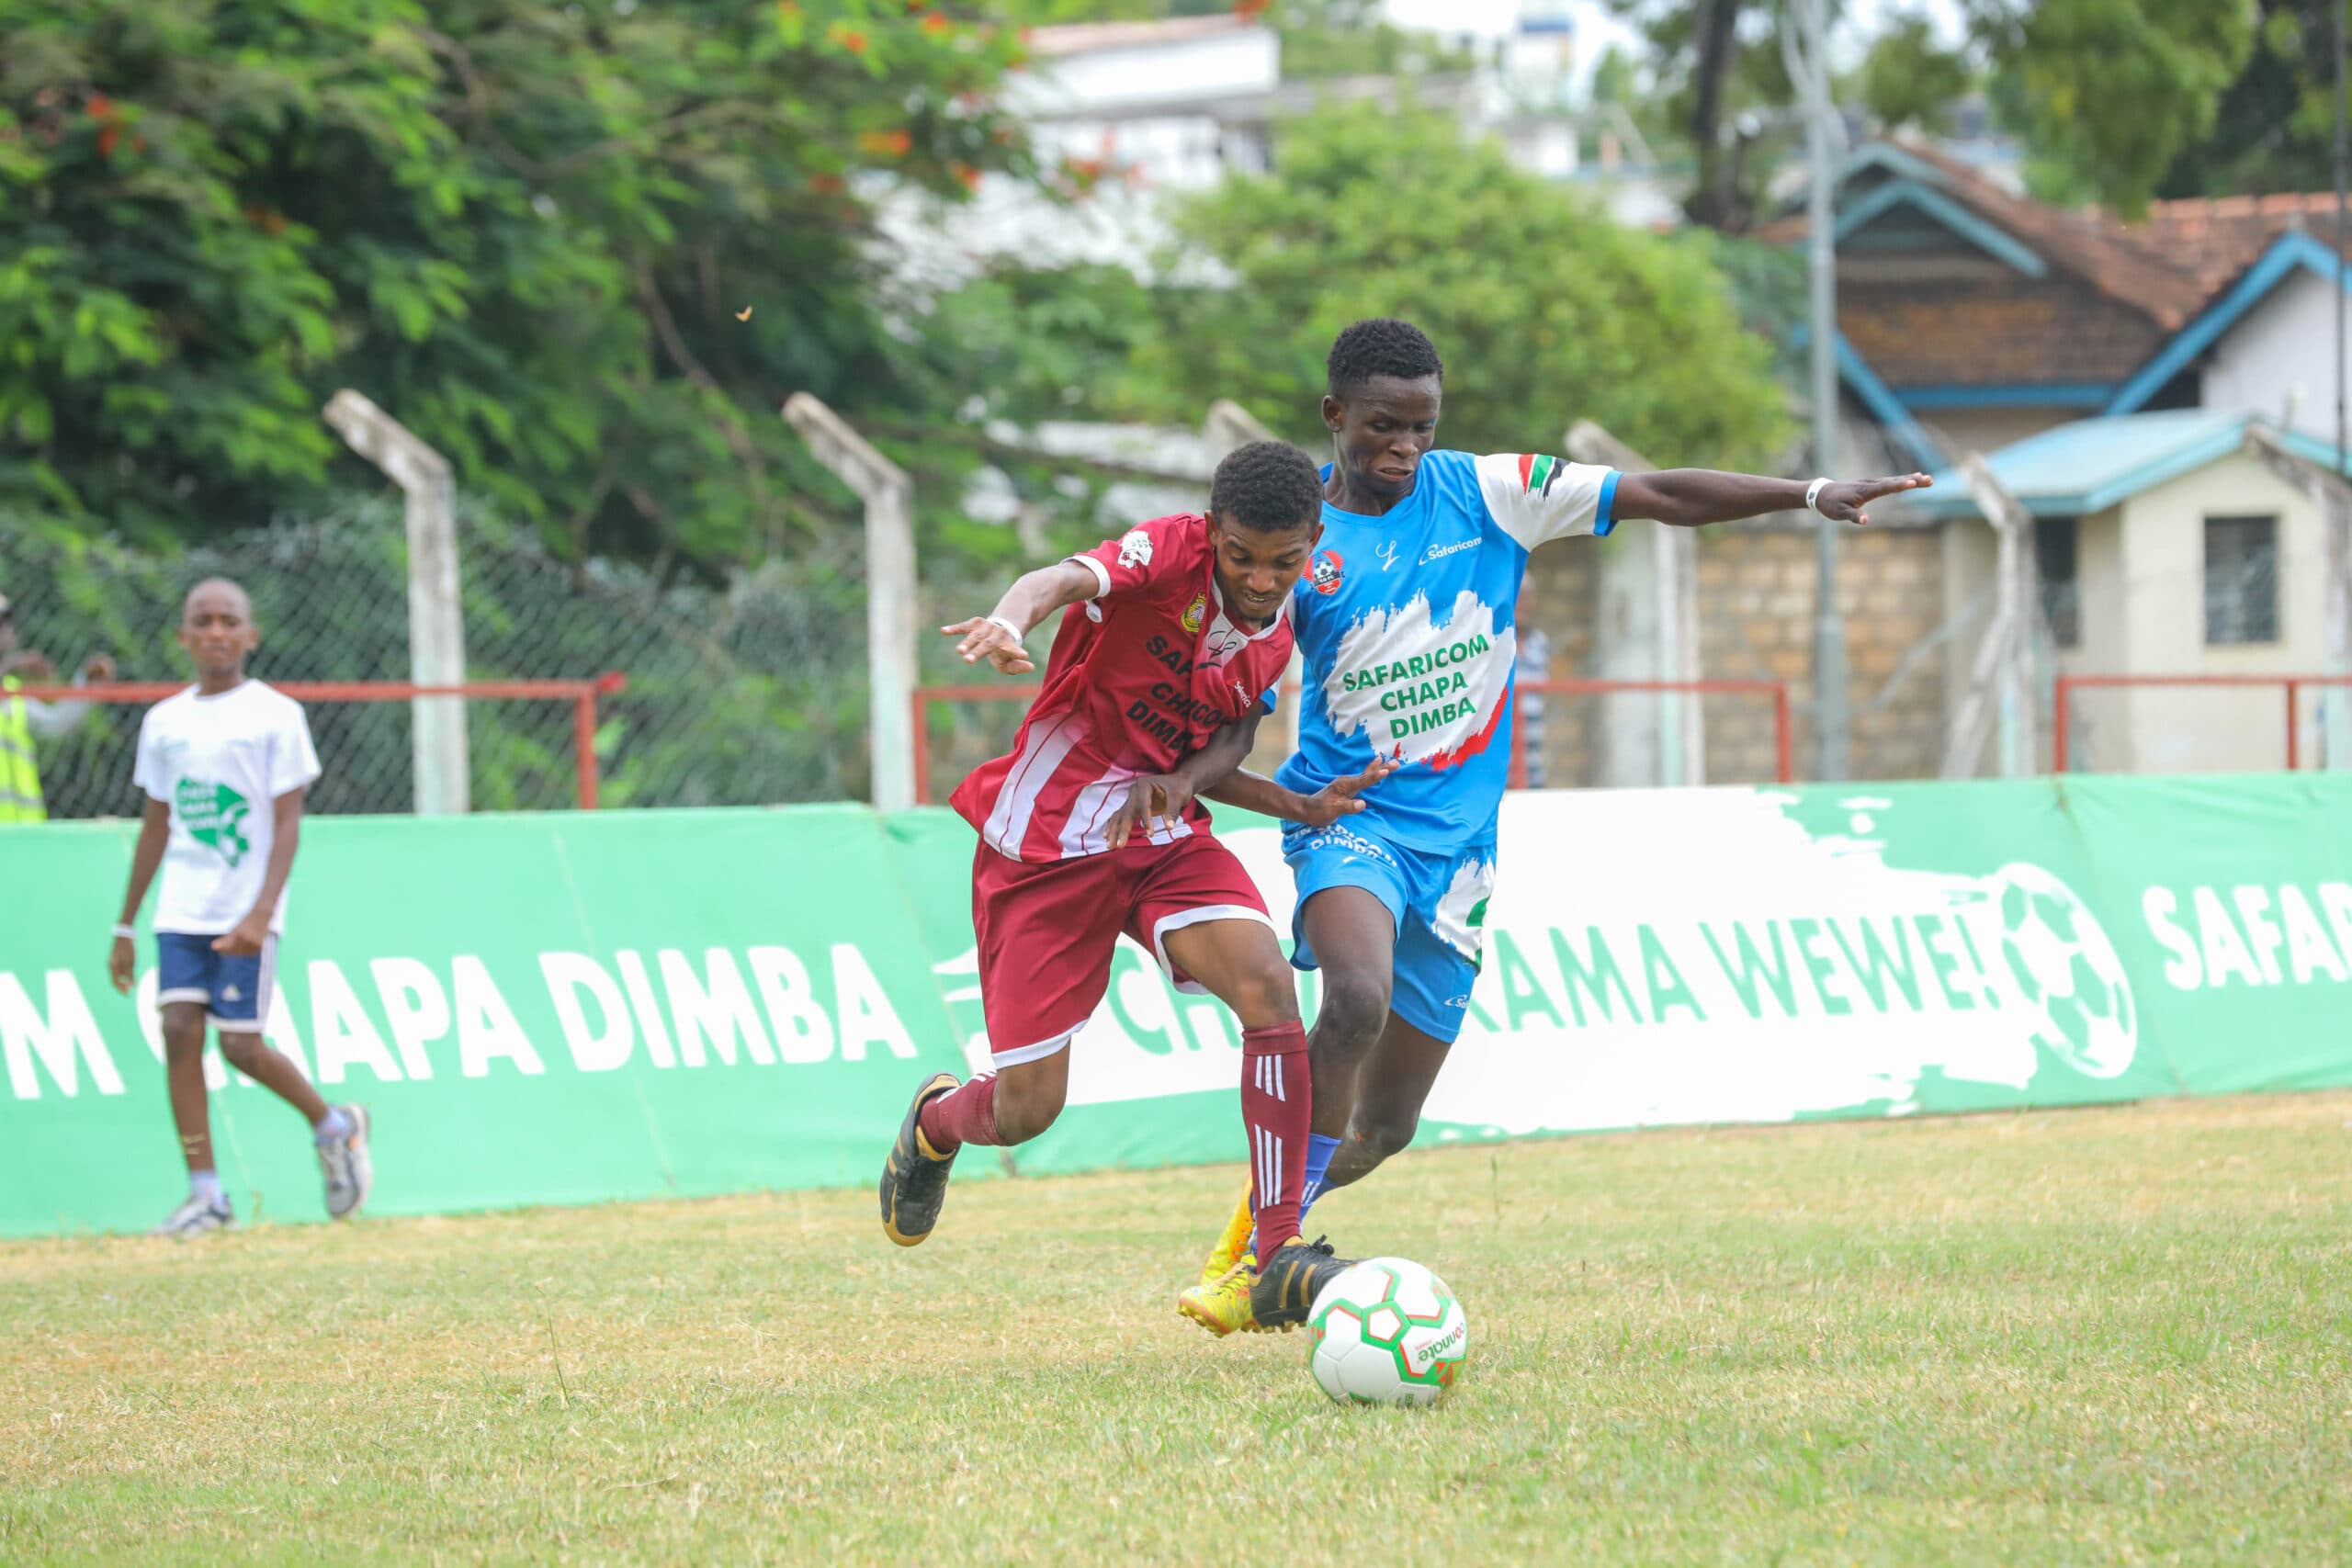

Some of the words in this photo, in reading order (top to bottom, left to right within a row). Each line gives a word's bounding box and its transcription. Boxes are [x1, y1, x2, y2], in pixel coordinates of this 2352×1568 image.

[1427, 536, 1483, 560] Safaricom
[1342, 634, 1489, 692] SAFARICOM
[1380, 671, 1468, 712] CHAPA
[1390, 696, 1476, 739] DIMBA
[1698, 913, 2003, 1020] WEWE!
[137, 955, 546, 1090] APA
[537, 943, 918, 1073] DIMBA
